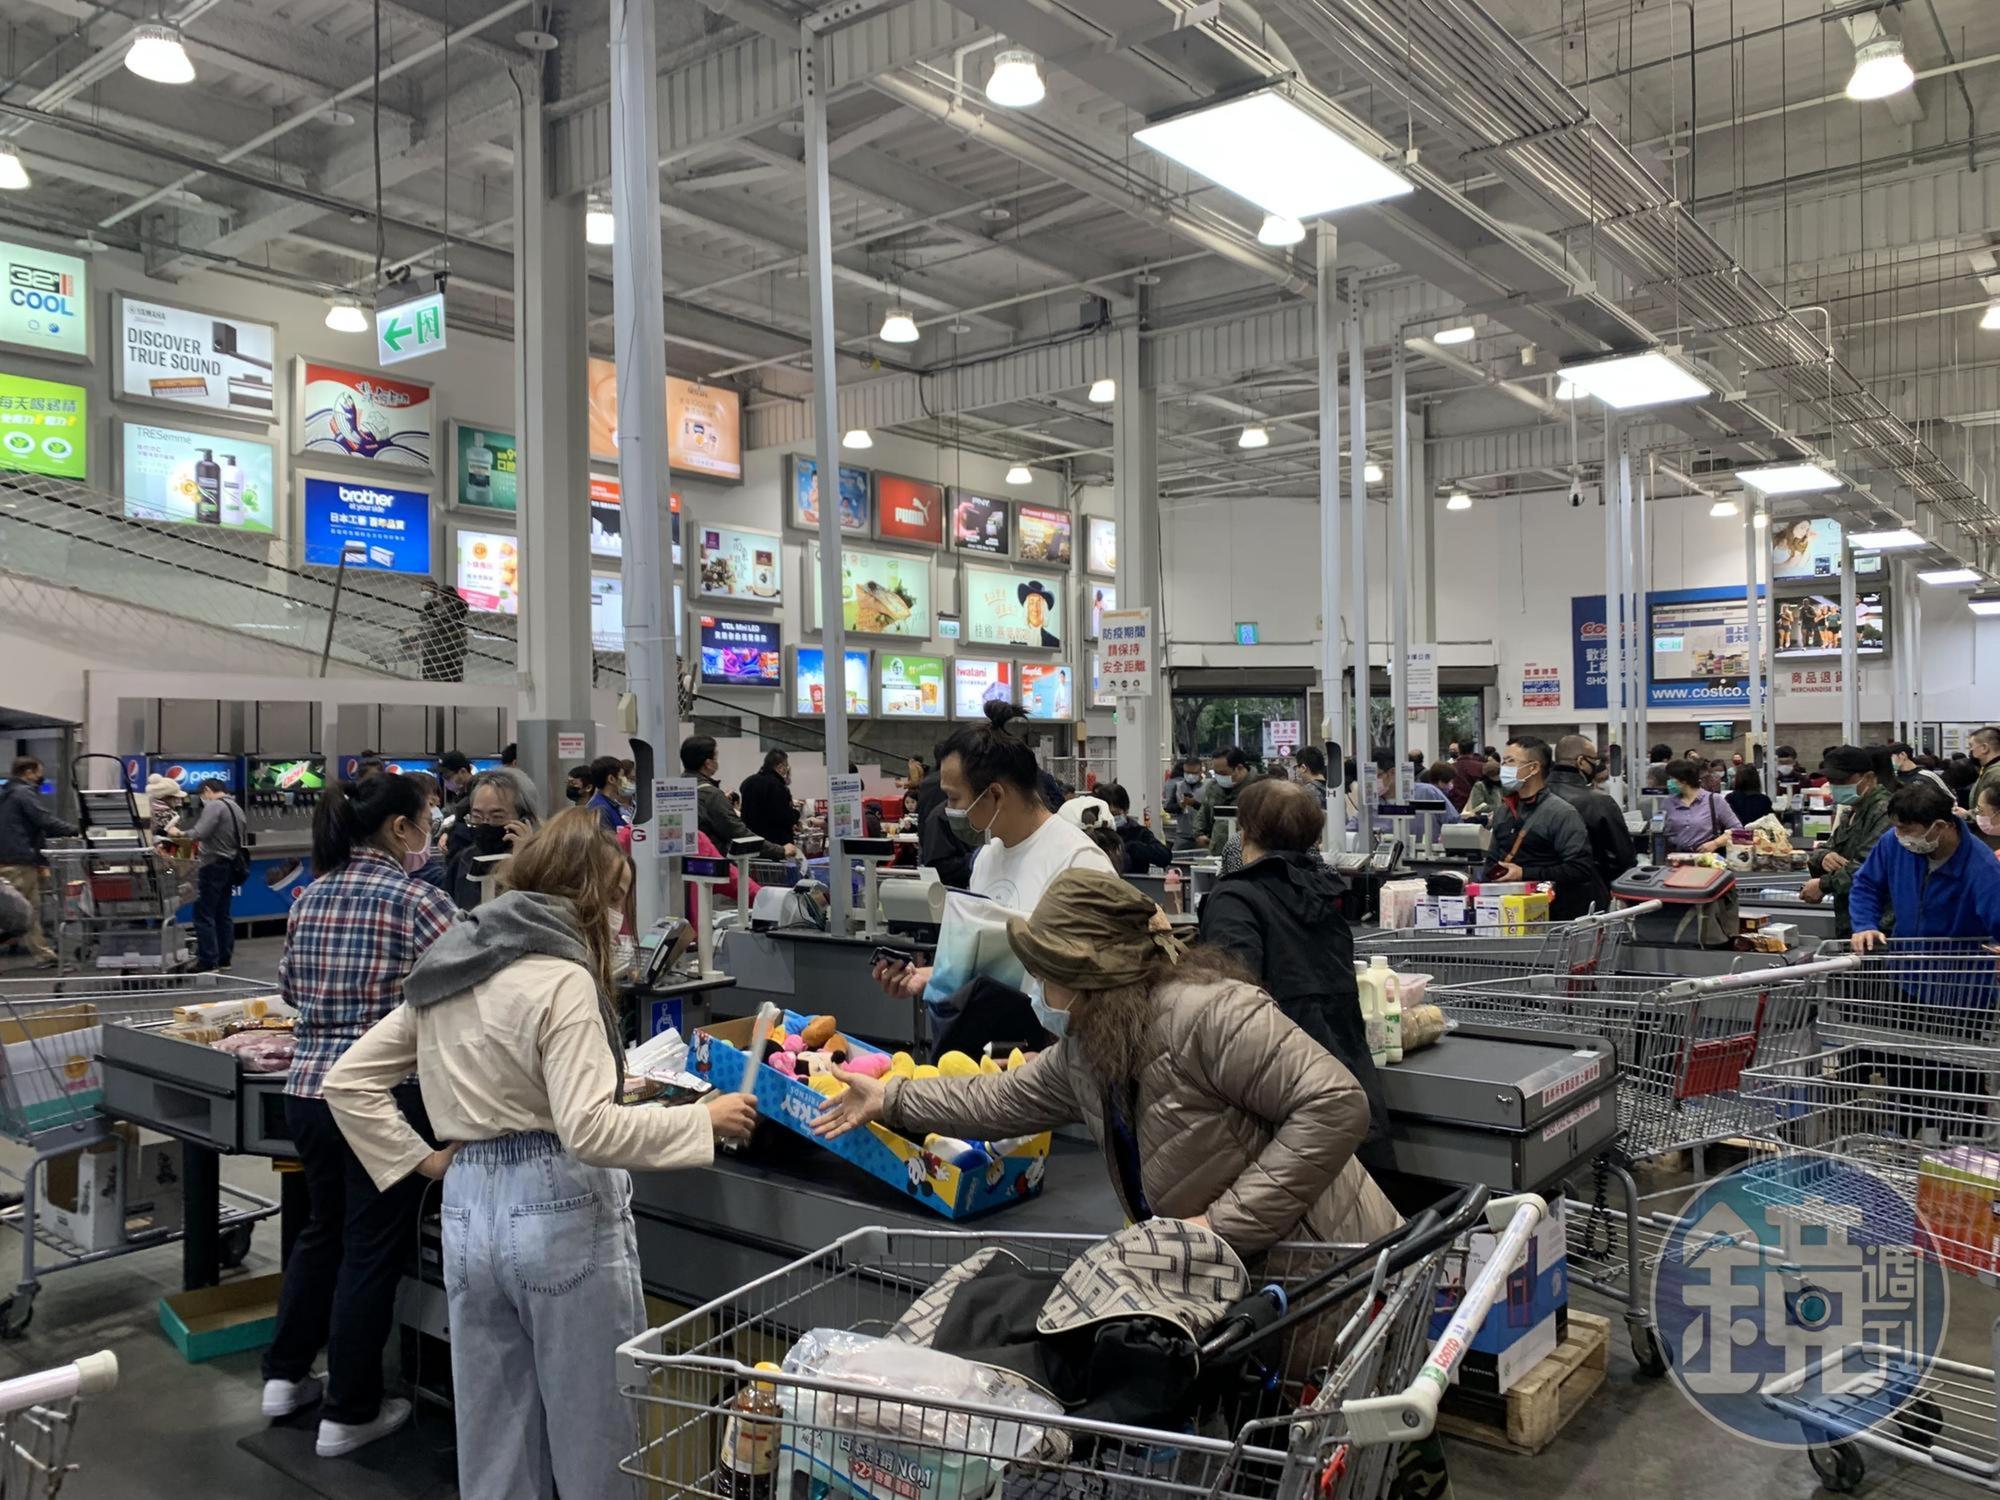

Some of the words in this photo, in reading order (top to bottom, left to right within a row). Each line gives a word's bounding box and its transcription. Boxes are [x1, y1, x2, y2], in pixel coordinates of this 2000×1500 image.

[10, 289, 74, 316] COOL
[128, 327, 201, 355] DISCOVER
[128, 346, 167, 368] TRUE
[171, 353, 221, 376] SOUND
[137, 427, 192, 444] TRESemmé
[339, 486, 395, 507] brother
[972, 497, 990, 507] PNY
[895, 507, 924, 526] PUMA
[1103, 626, 1146, 640] 防疫期間
[1108, 643, 1140, 657] 請保持
[1103, 660, 1146, 674] 安全距離
[631, 829, 646, 841] G
[897, 1456, 932, 1489] NO.1
